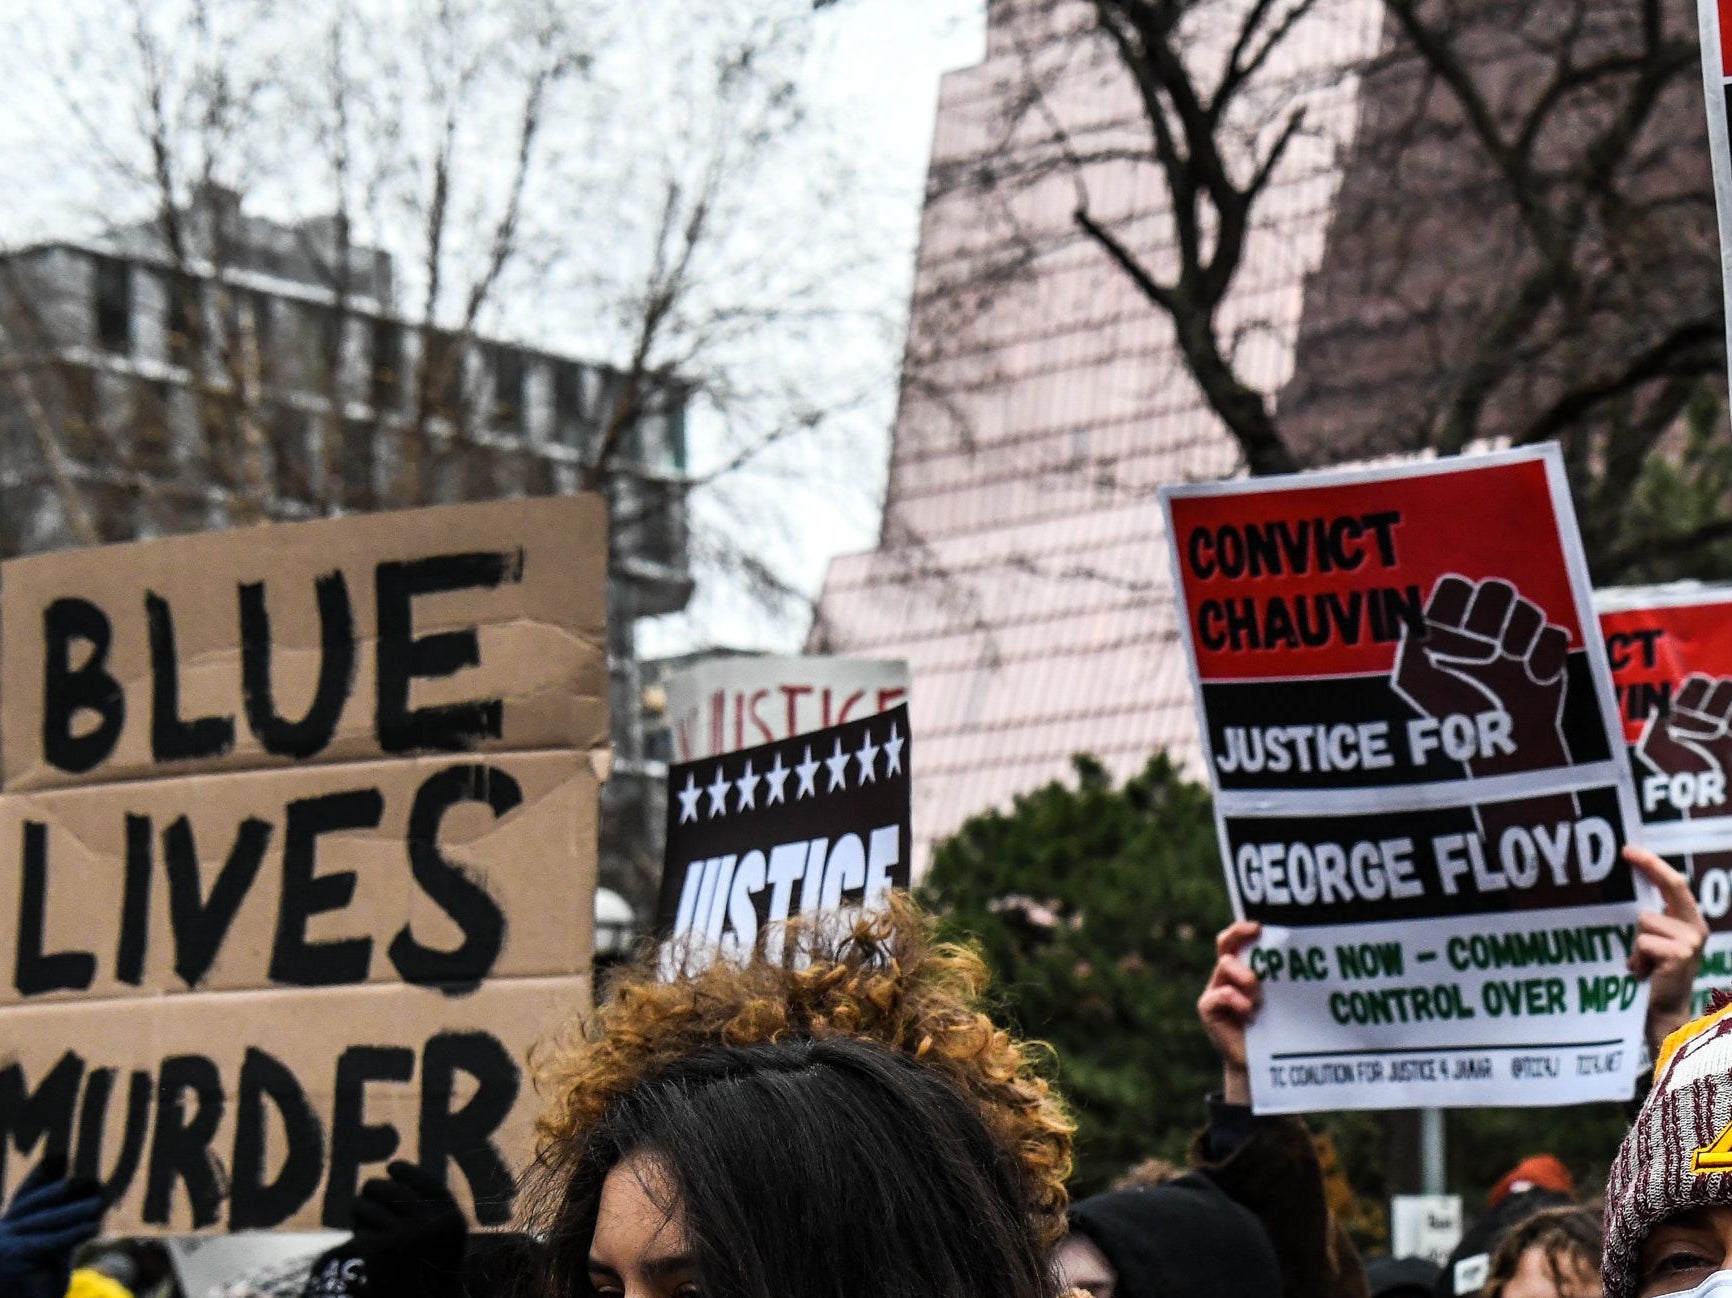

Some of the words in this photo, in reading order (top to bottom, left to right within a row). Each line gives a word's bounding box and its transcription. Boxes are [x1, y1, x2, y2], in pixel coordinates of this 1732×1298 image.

[1188, 512, 1400, 580] CONVICT
[1199, 585, 1429, 651] CHAUVIN
[42, 545, 524, 773] BLUE
[1216, 721, 1393, 772] JUSTICE
[1408, 710, 1515, 764] FOR
[1642, 772, 1727, 811] FOR
[14, 764, 524, 996] LIVES
[1236, 838, 1423, 905] GEORGE
[1433, 818, 1616, 880] FLOYD
[655, 824, 900, 984] JUSTICE
[1251, 942, 1328, 982] CPAC
[1337, 939, 1403, 975] NOW
[1447, 925, 1636, 969] COMMUNITY
[1330, 983, 1473, 1024] CONTROL
[1483, 978, 1567, 1018] OVER
[1578, 975, 1637, 1012] MPD
[1357, 1059, 1384, 1083] FOR
[1388, 1058, 1436, 1082] JUSTICE
[0, 1030, 524, 1232] MURDER
